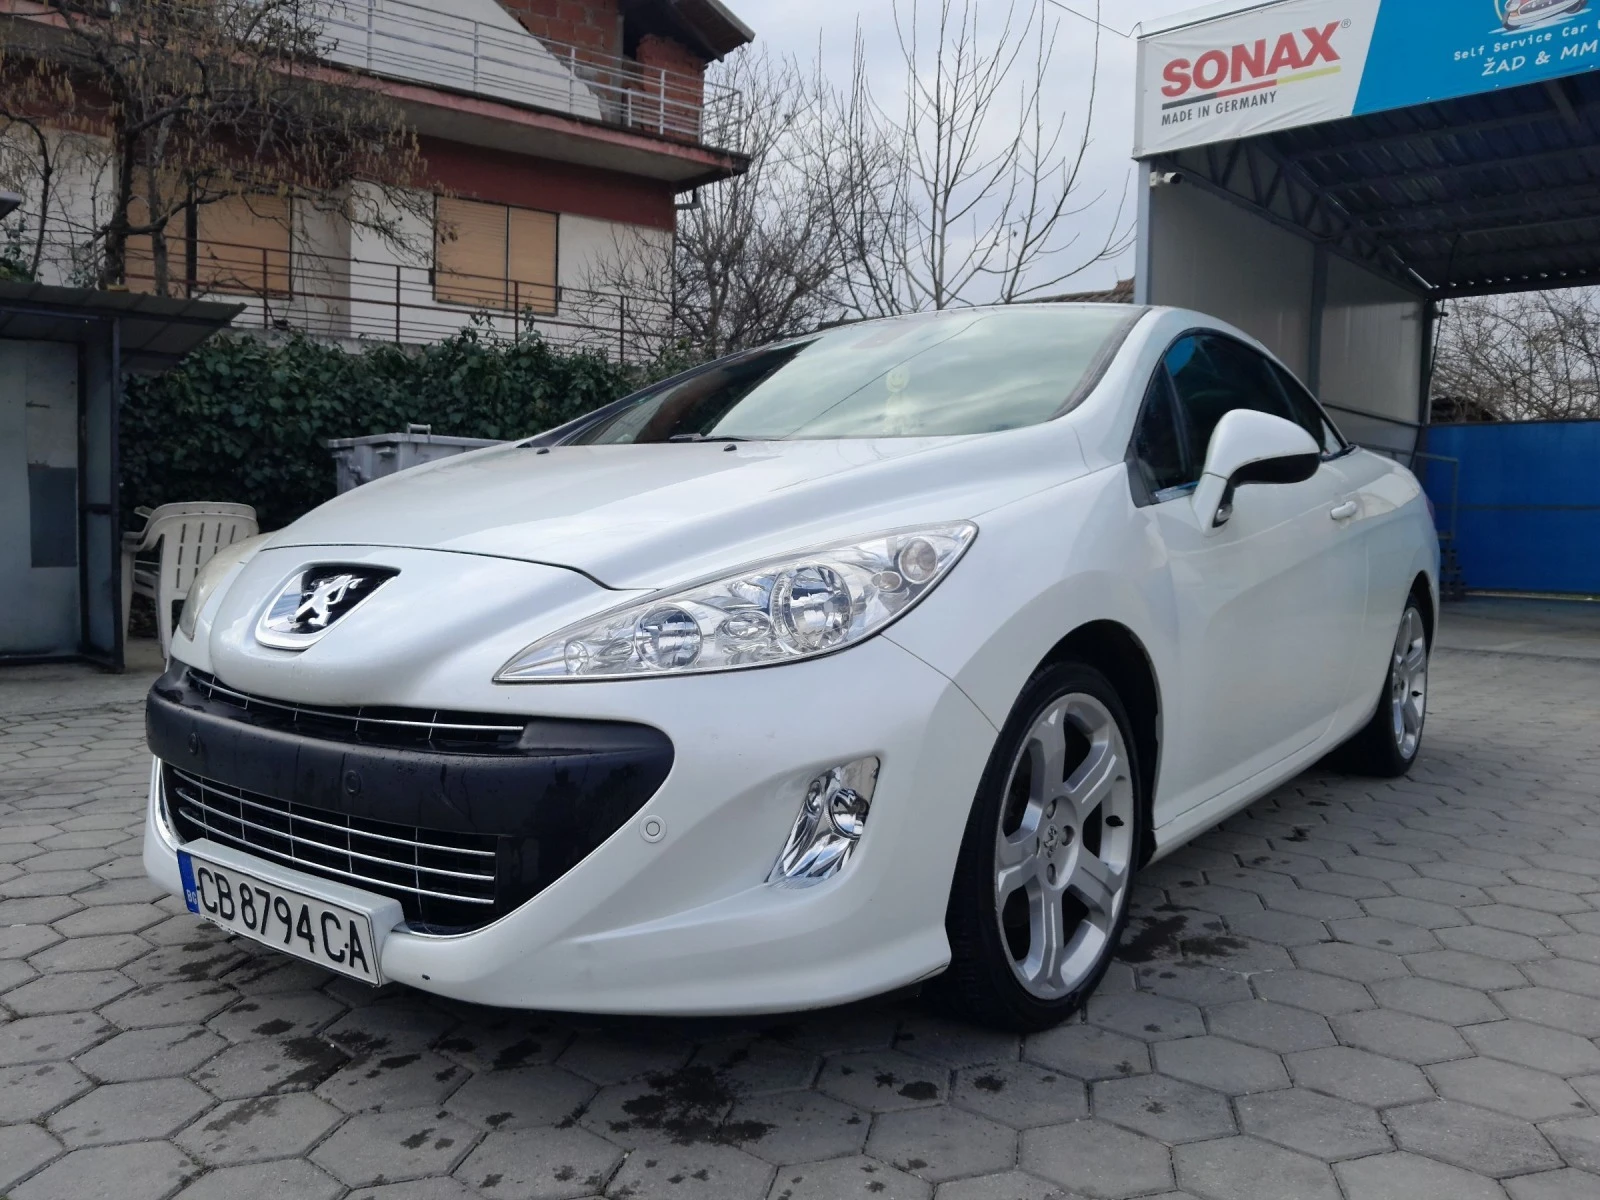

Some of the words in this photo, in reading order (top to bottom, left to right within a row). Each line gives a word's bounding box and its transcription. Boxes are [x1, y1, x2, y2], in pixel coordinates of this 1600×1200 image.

[1454, 45, 1485, 60] Self
[1494, 32, 1552, 52] Service
[1562, 24, 1588, 37] Car
[1481, 55, 1526, 76] ŽAD
[1535, 50, 1551, 65] &
[1161, 108, 1193, 126] MADE
[1198, 105, 1210, 119] IN
[1216, 91, 1277, 115] GERMANY
[186, 888, 198, 905] BG
[197, 867, 235, 920] CB
[239, 882, 315, 954] 8794
[321, 910, 370, 974] CA
